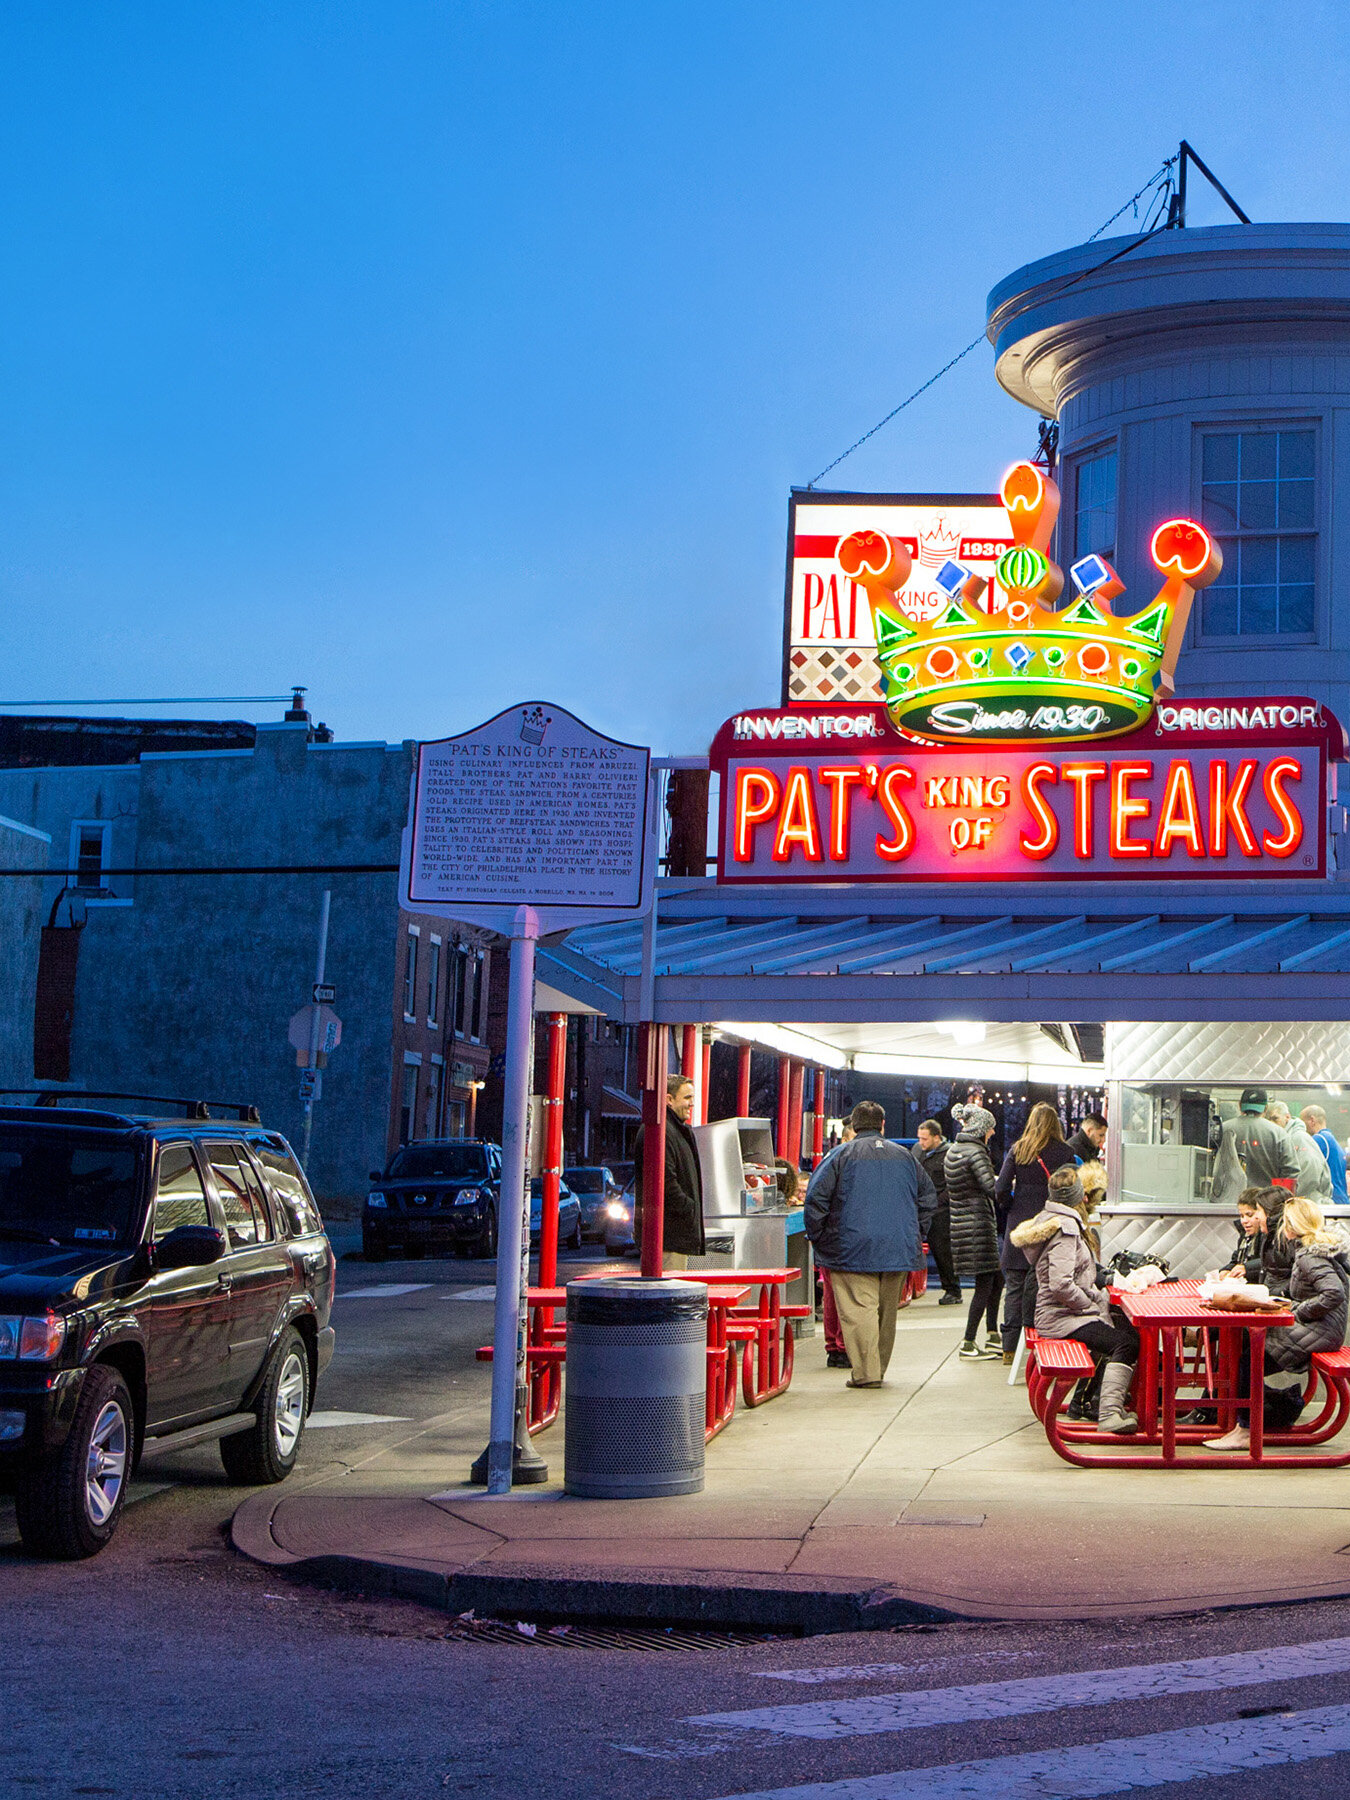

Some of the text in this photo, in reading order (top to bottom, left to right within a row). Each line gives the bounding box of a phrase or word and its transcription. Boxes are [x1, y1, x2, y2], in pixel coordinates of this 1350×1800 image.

[962, 543, 1007, 556] 1930
[800, 572, 867, 639] PAT
[896, 591, 939, 606] KING
[931, 701, 1105, 734] Since 1930
[1160, 705, 1318, 731] ORIGINATOR
[733, 716, 877, 740] INVENTOR
[497, 744, 532, 757] KING
[537, 746, 557, 758] OF
[429, 759, 455, 767] USING
[460, 760, 503, 768] CULINARY
[509, 761, 564, 769] INFLUENCES
[462, 770, 511, 778] BROTHERS
[517, 771, 533, 779] PAT
[563, 772, 591, 780] HARRY
[599, 773, 638, 781] OLIVIERI
[572, 782, 612, 790] FAVORITE
[459, 788, 476, 796] THE
[480, 789, 506, 797] STEAK
[556, 791, 580, 799] FROM
[591, 792, 637, 800] CENTURIES
[452, 798, 483, 806] RECIPE
[515, 799, 525, 807] IN
[530, 800, 572, 808] AMERICAN
[425, 807, 457, 815] STEAKS
[460, 808, 511, 816] ORIGINATED
[514, 809, 536, 817] HERE
[540, 809, 549, 817] IN
[552, 810, 570, 818] 1930
[594, 811, 636, 819] INVENTED
[733, 756, 1304, 863] PAT'S KING OF STEAKS
[425, 816, 442, 824] THE
[444, 817, 492, 825] PROTOTYPE
[509, 818, 557, 827] BEEFSTEAK
[560, 819, 611, 828] SANDWICHES
[614, 821, 635, 829] THAT
[424, 826, 445, 834] USES
[463, 827, 527, 835] ITALIAN-STYLE
[531, 828, 554, 836] ROLL
[557, 829, 574, 837] AND
[423, 835, 448, 843] SINCE
[498, 837, 532, 845] STEAKS
[555, 838, 585, 846] SHOWN
[589, 839, 603, 847] ITS
[423, 844, 634, 857] TALITY TO CELEBRITIES AND POLITICIANS KNOWN
[485, 855, 501, 863] AND
[505, 855, 521, 863] HAS
[526, 856, 537, 864] AN
[541, 856, 592, 865] IMPORTANT
[597, 858, 619, 866] PART
[422, 863, 438, 871] THE
[441, 863, 460, 871] CITY
[463, 864, 474, 872] OF
[541, 866, 565, 874] PLACE
[567, 867, 577, 875] IN
[580, 867, 596, 875] THE
[599, 868, 633, 876] HISTORY
[421, 872, 433, 880] OF
[437, 873, 480, 881] AMERICAN
